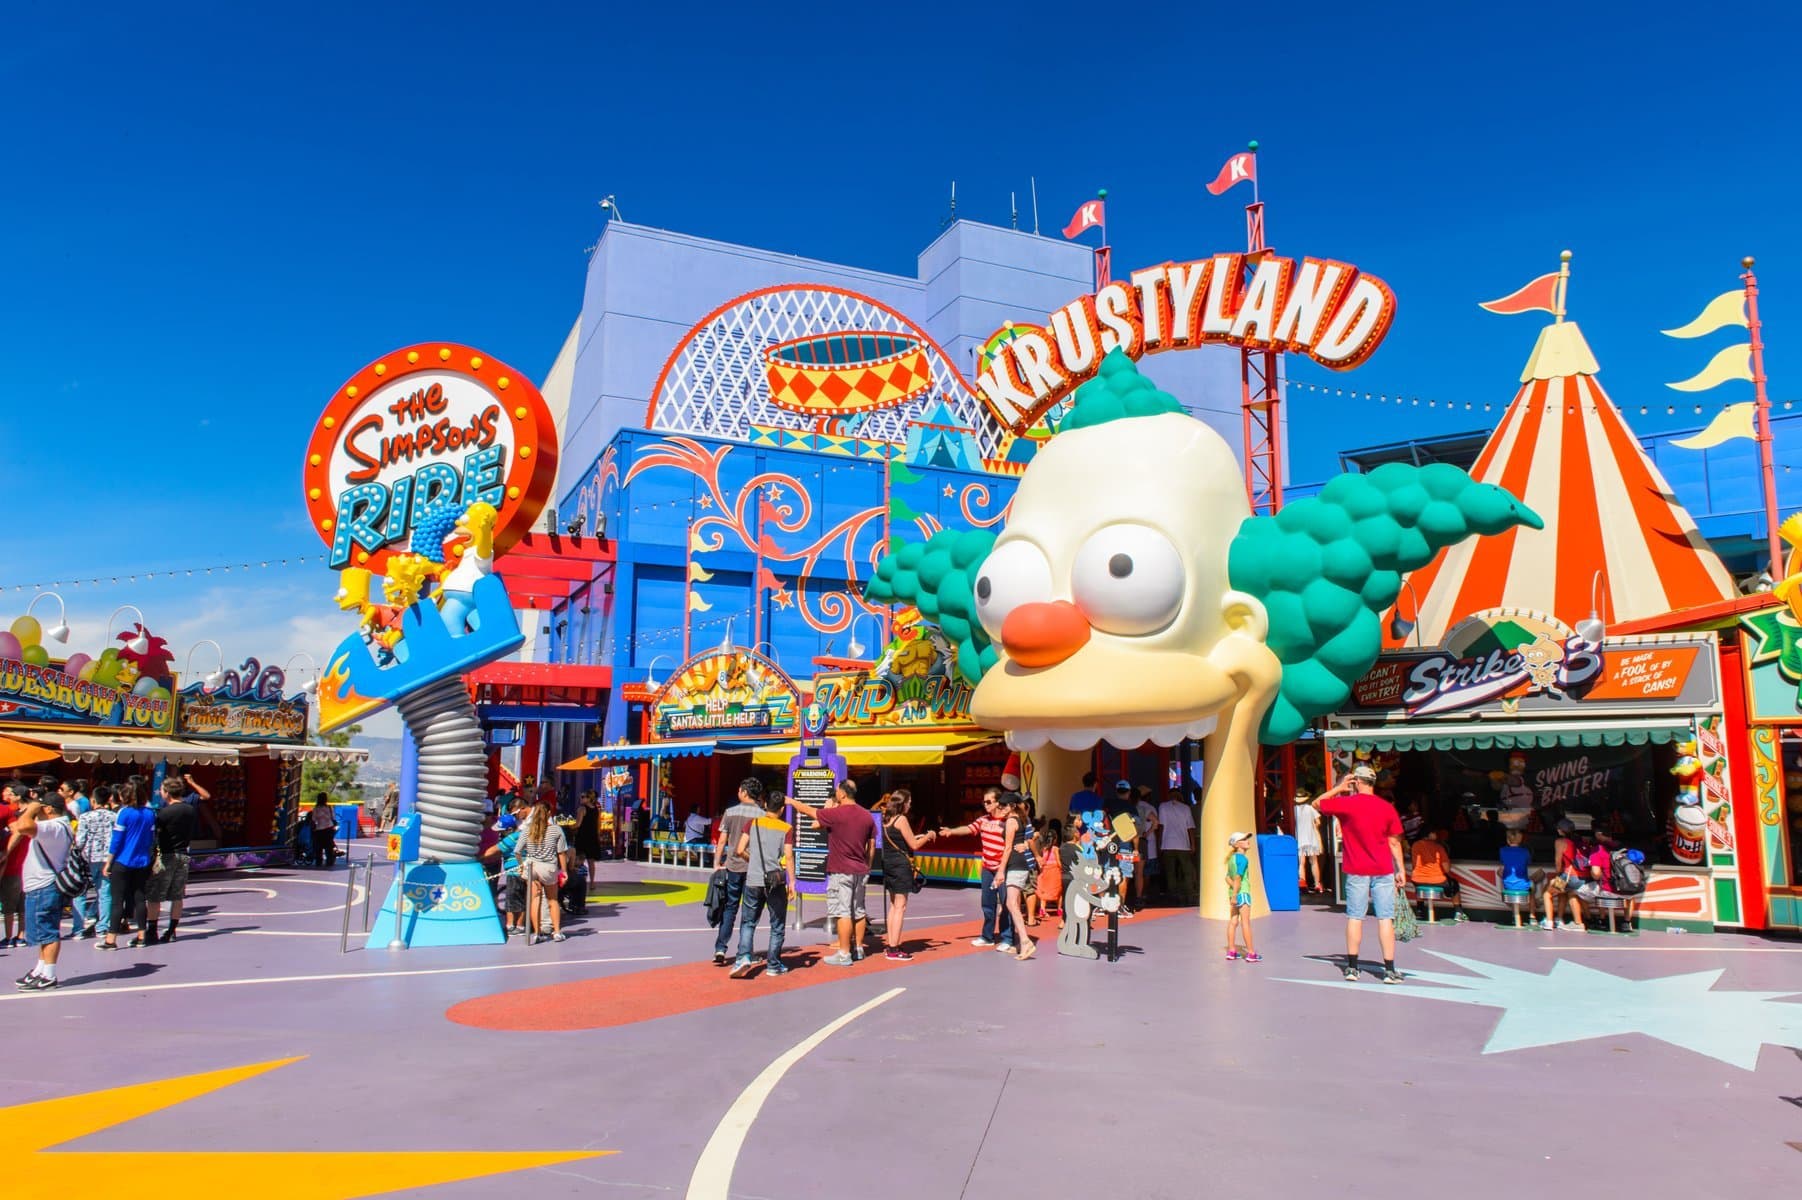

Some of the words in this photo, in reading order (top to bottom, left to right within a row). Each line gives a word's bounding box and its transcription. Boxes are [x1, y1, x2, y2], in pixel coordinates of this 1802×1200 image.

[1230, 155, 1249, 181] K
[1081, 203, 1098, 226] K
[976, 255, 1392, 430] KRUSTYLAND
[329, 444, 506, 570] RIDE
[1369, 664, 1398, 680] CAN'T
[1402, 649, 1524, 703] Strike
[1557, 635, 1603, 687] 3
[1620, 663, 1647, 678] FOOL
[1649, 662, 1660, 671] OF
[1378, 683, 1400, 698] TRY!
[1642, 676, 1677, 694] CANS!
[120, 692, 170, 728] YOU
[705, 699, 729, 712] HELP
[901, 704, 927, 723] AND
[704, 712, 732, 728] LITTLE
[734, 711, 769, 727] HELPER
[1535, 756, 1588, 788] SWING
[1541, 769, 1610, 807] BATTER!
